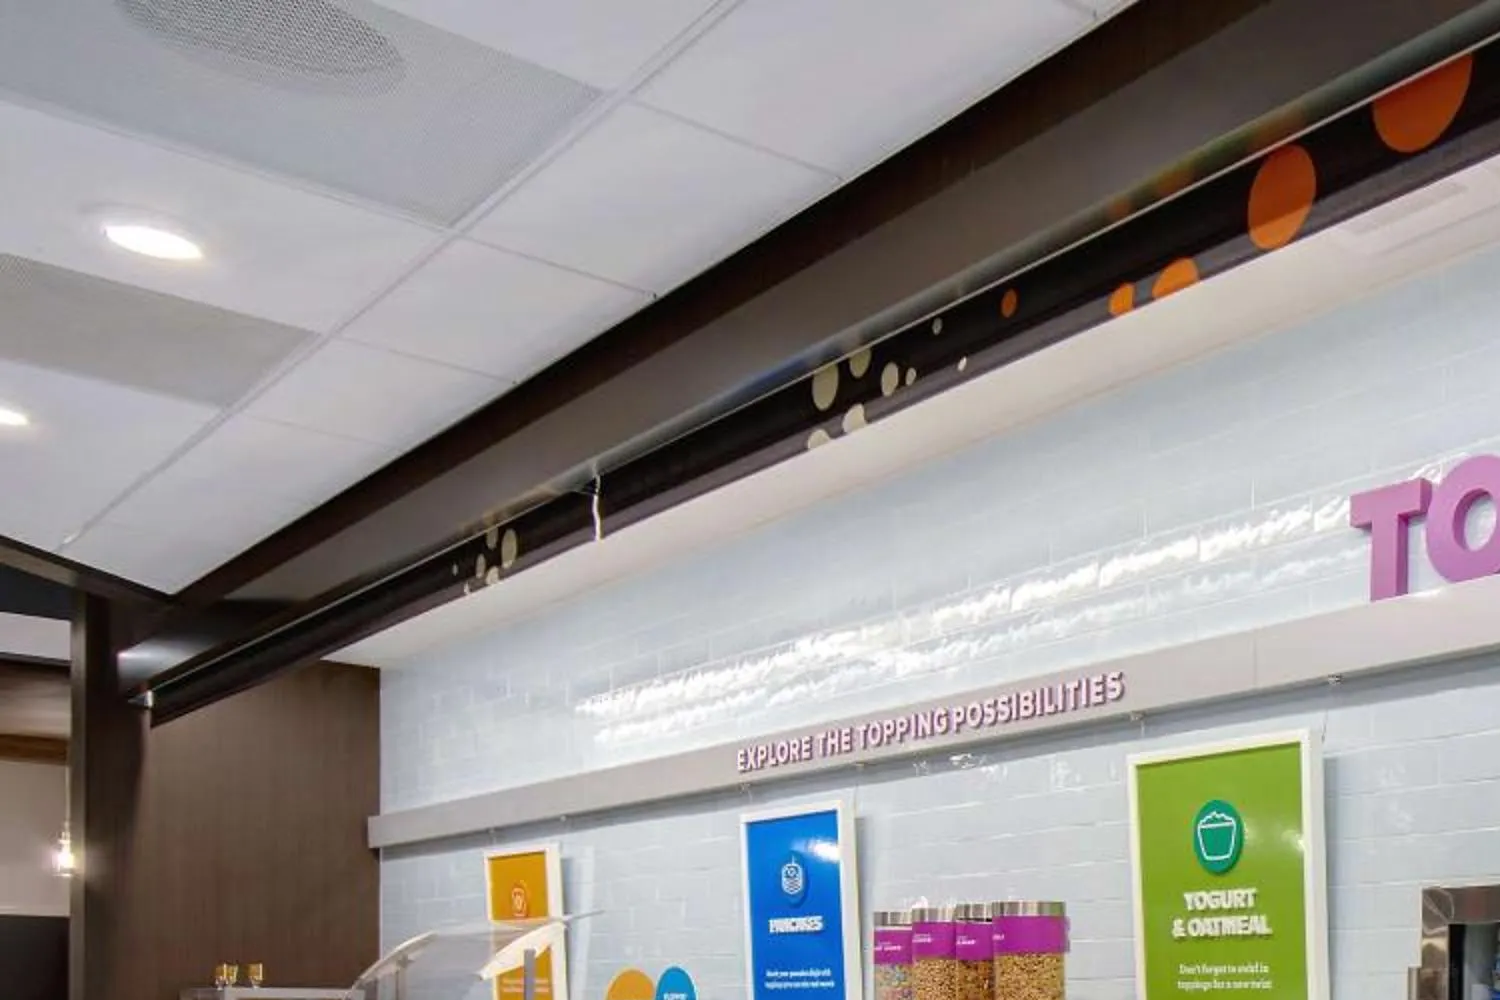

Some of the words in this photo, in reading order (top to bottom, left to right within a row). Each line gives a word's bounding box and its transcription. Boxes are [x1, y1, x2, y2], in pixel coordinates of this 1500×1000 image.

[736, 737, 813, 773] EXPLORE
[818, 727, 853, 757] THE
[859, 709, 948, 750] TOPPING
[953, 671, 1125, 734] POSSIBILITIES
[1184, 888, 1257, 911] YOGURT
[1172, 918, 1187, 938] &
[1188, 915, 1273, 937] OATMEAL
